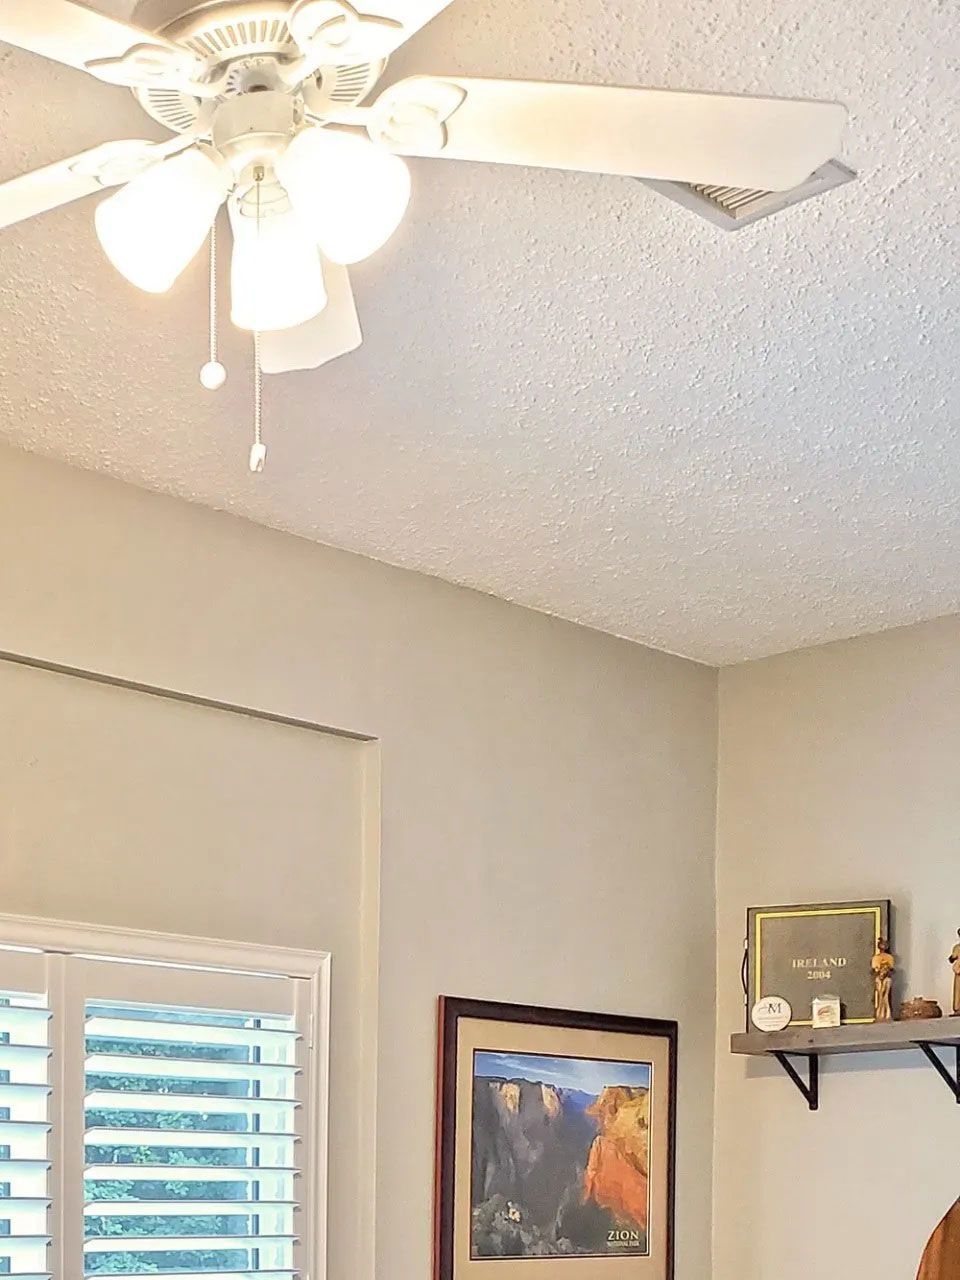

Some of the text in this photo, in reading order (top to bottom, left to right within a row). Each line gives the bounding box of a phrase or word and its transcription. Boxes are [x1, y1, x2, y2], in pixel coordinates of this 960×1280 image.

[792, 957, 847, 969] IRELAND
[807, 970, 832, 980] 2004
[607, 1230, 639, 1241] ZION
